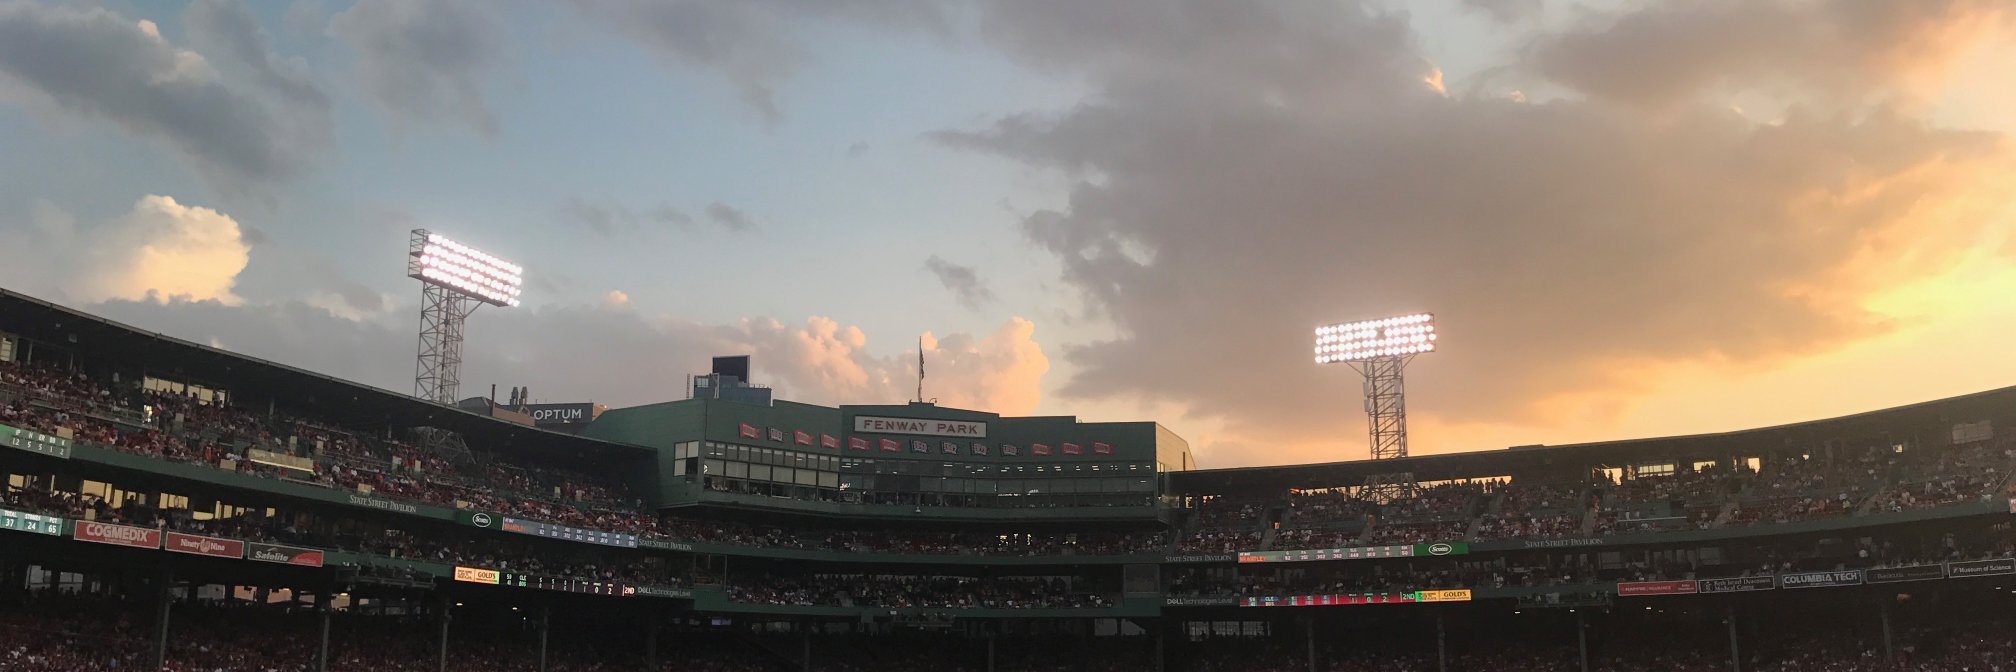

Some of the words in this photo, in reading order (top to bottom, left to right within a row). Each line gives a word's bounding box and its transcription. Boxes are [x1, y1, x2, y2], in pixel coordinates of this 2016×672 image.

[534, 408, 582, 420] OPTUM
[863, 419, 928, 432] FENWAY
[937, 423, 978, 435] PARK
[349, 494, 368, 505] STATE
[368, 497, 388, 509] STREET
[389, 500, 417, 513] PAVILION
[5, 518, 15, 527] 37
[27, 521, 36, 530] 24
[48, 524, 57, 533] 65
[86, 523, 148, 543] COGMEDIX
[180, 538, 201, 549] Ninety
[210, 542, 226, 552] Nine
[255, 550, 289, 562] Safelite
[1783, 573, 1833, 584] COLUMBIA
[1833, 572, 1858, 581] TECH
[624, 586, 635, 594] 2ND
[637, 586, 652, 594] DELL
